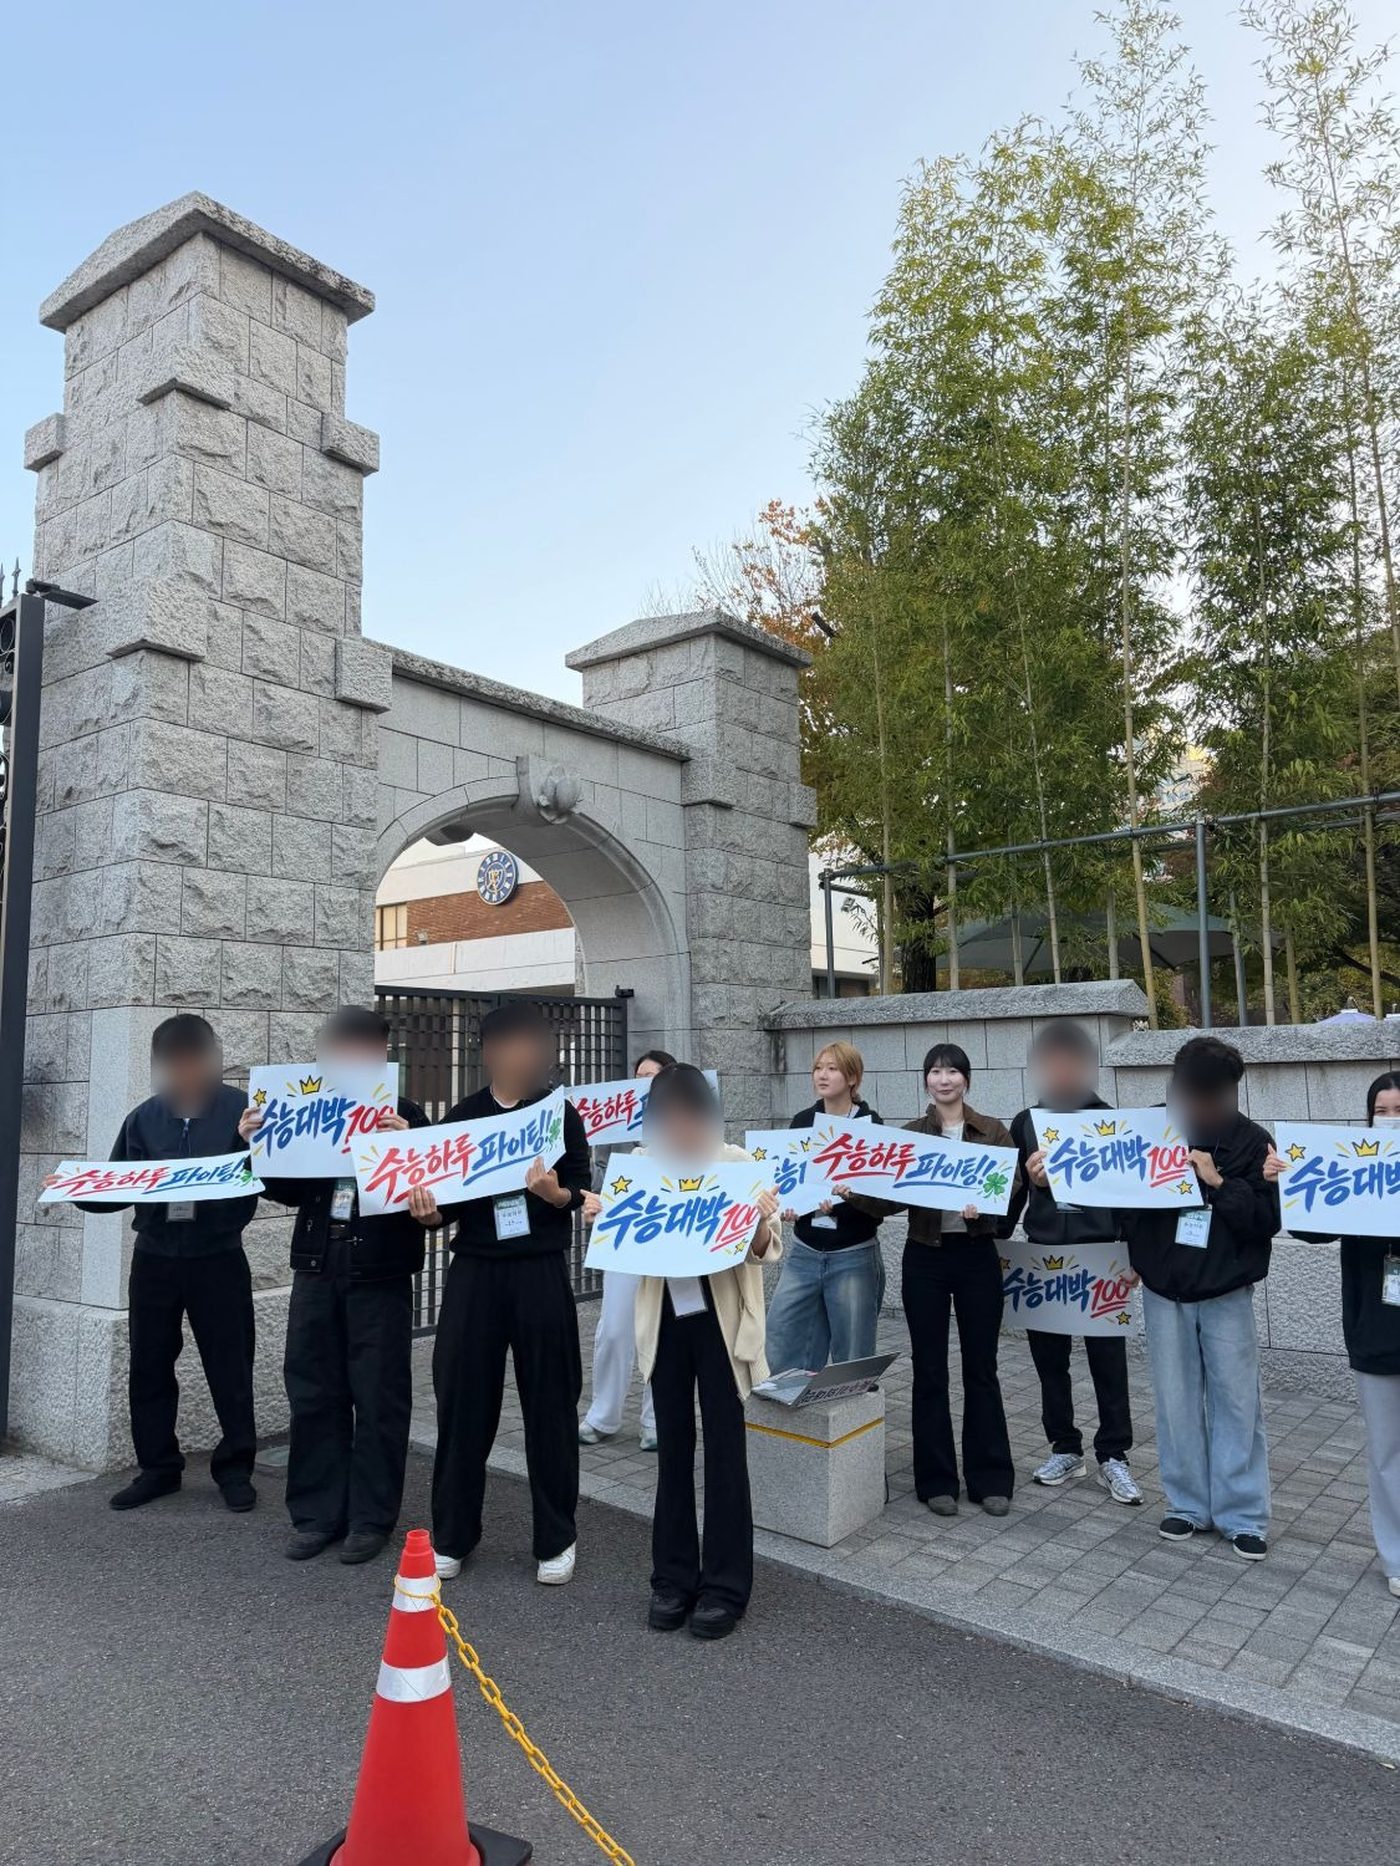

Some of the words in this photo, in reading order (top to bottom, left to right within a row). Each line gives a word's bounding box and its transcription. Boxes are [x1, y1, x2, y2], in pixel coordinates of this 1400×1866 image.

[252, 1098, 357, 1158] 수능대박
[52, 1166, 171, 1199] 수능하루
[364, 1132, 478, 1209] 수능하루
[471, 1109, 553, 1172] 파이팅!!
[812, 1132, 917, 1181] 수능하루
[904, 1153, 998, 1185] 파이팅!!
[1048, 1134, 1152, 1189] 수능대박
[1147, 1145, 1188, 1181] 100
[597, 1189, 734, 1251] 수능대박
[1001, 1266, 1097, 1313] 수능대박
[1090, 1278, 1132, 1312] 100
